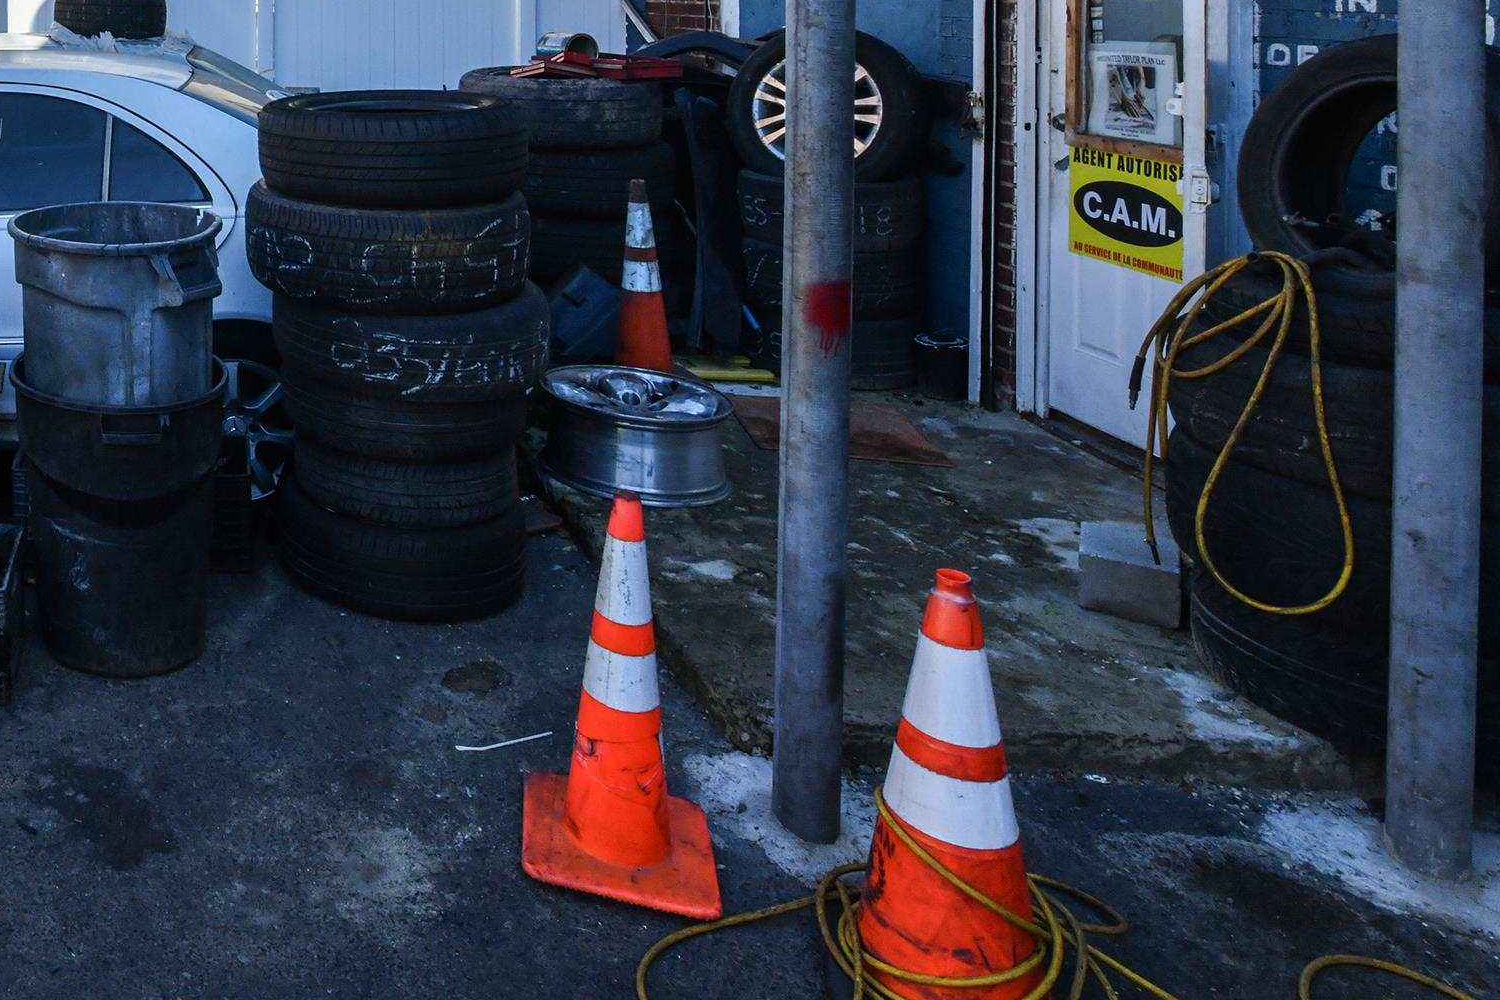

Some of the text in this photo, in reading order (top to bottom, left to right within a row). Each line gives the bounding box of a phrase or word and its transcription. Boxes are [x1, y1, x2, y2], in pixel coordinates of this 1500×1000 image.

[1073, 147, 1113, 169] AGENT
[1082, 190, 1176, 238] C.A.M.
[1084, 243, 1111, 260] SERVICE
[1113, 252, 1122, 262] DE
[1123, 255, 1131, 265] LA
